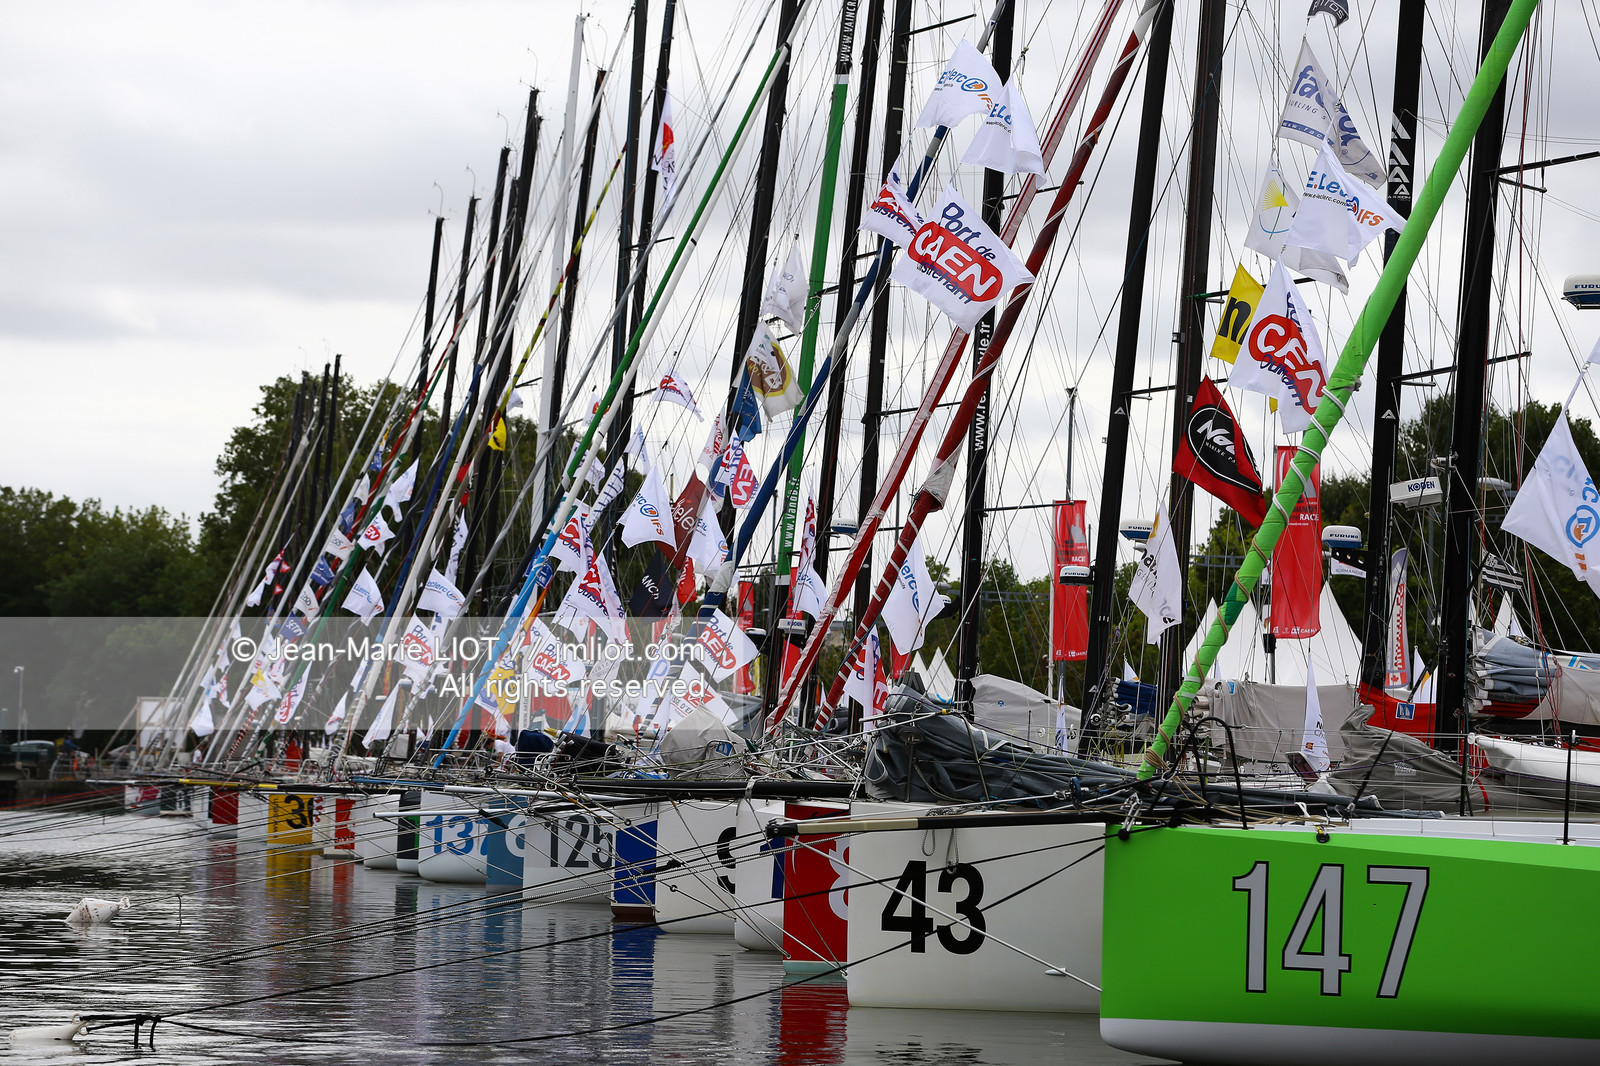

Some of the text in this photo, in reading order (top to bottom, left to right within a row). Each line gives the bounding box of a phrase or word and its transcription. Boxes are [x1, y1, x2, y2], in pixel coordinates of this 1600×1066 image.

[937, 202, 996, 262] Port de
[1356, 209, 1384, 226] IFS
[914, 228, 997, 298] CAEN
[1407, 480, 1436, 492] KODEN
[1299, 513, 1320, 521] RACE
[543, 812, 613, 868] 125
[881, 859, 986, 955] 43
[1232, 860, 1431, 999] 147
